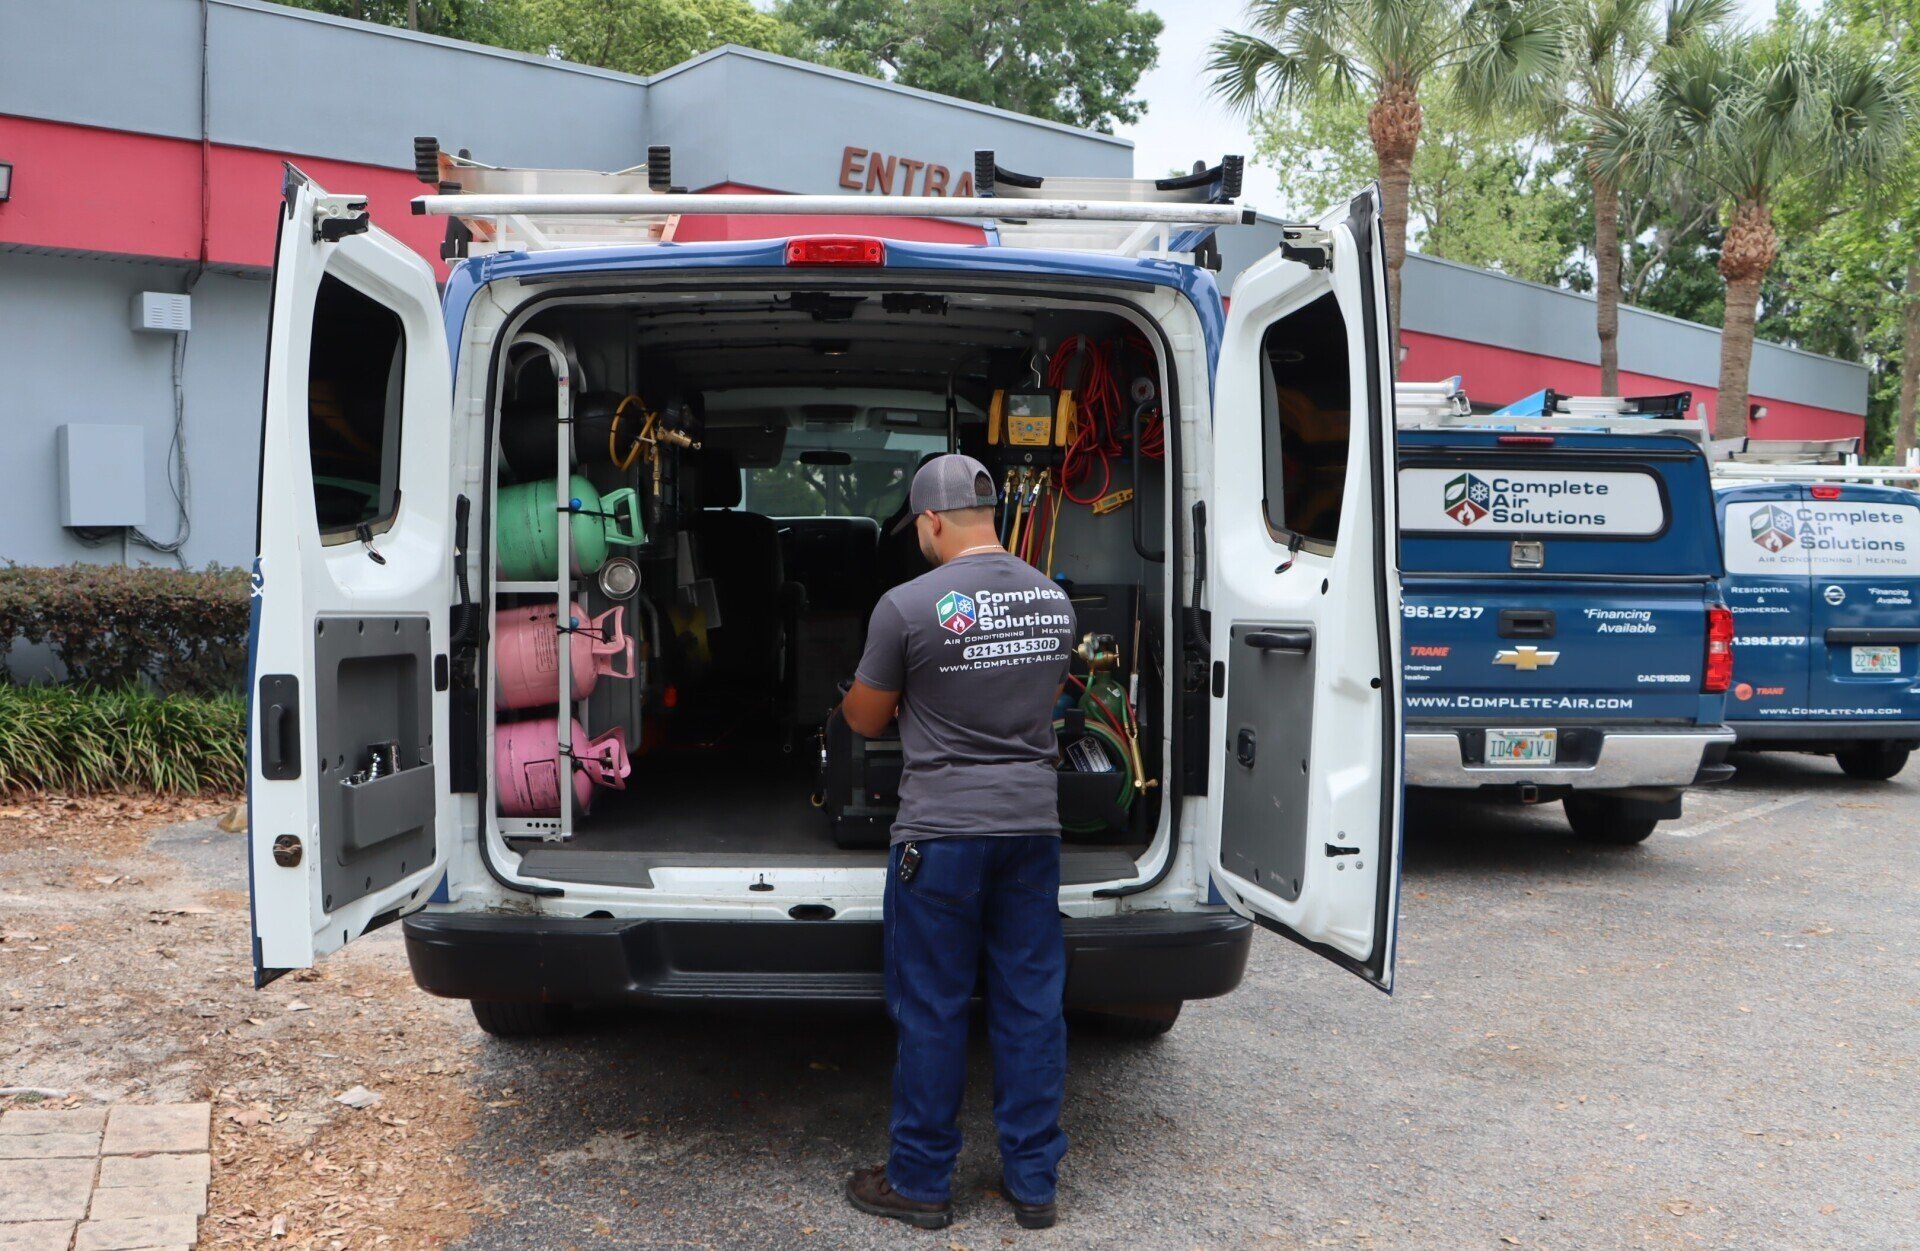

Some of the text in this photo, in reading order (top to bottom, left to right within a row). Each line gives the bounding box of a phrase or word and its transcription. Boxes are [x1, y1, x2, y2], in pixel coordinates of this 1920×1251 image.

[1492, 478, 1609, 498] Complete
[1491, 493, 1529, 508] Air
[1492, 509, 1606, 525] Solutions
[1796, 508, 1904, 524] Complete
[1798, 521, 1833, 536] Air
[1800, 536, 1905, 551] Solutions
[975, 587, 1066, 604] Complete
[977, 602, 1010, 618] Air
[979, 613, 1070, 631] Solutions
[1597, 623, 1657, 633] Available
[967, 639, 1057, 658] 321-313-5308
[1729, 636, 1806, 646] 1.396.2737
[1410, 646, 1450, 656] TRANE
